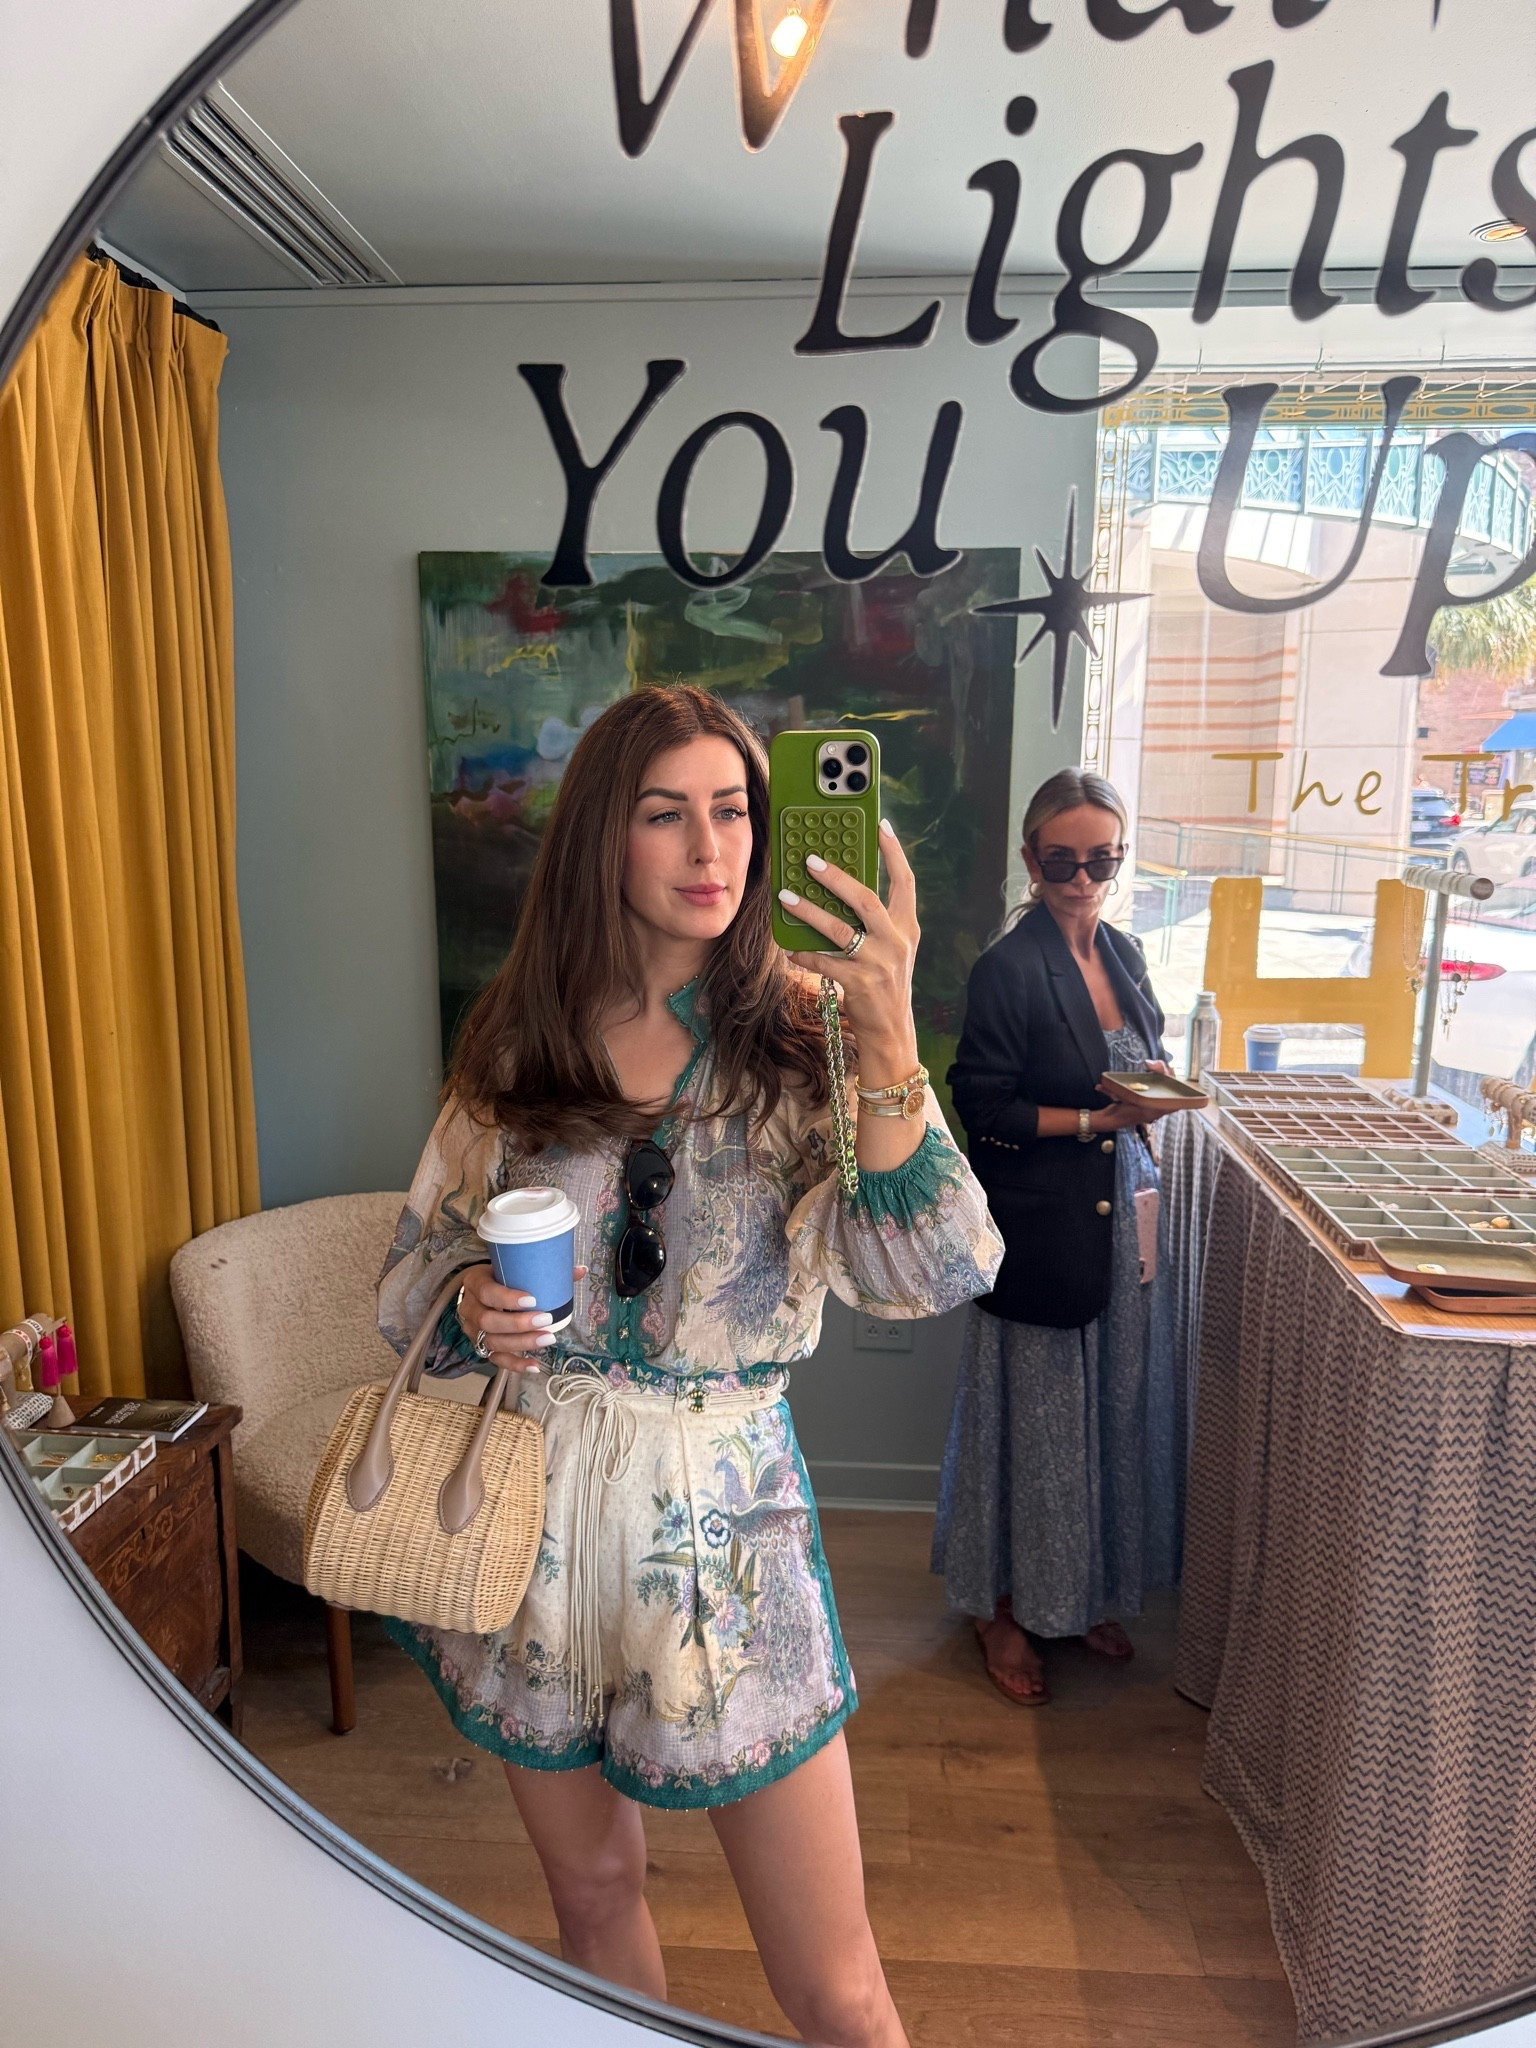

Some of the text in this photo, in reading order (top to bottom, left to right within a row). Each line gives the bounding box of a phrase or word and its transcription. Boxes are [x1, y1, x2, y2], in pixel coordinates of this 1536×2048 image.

[795, 59, 1536, 412] Lights
[517, 359, 1536, 677] You Up
[1211, 751, 1384, 816] The
